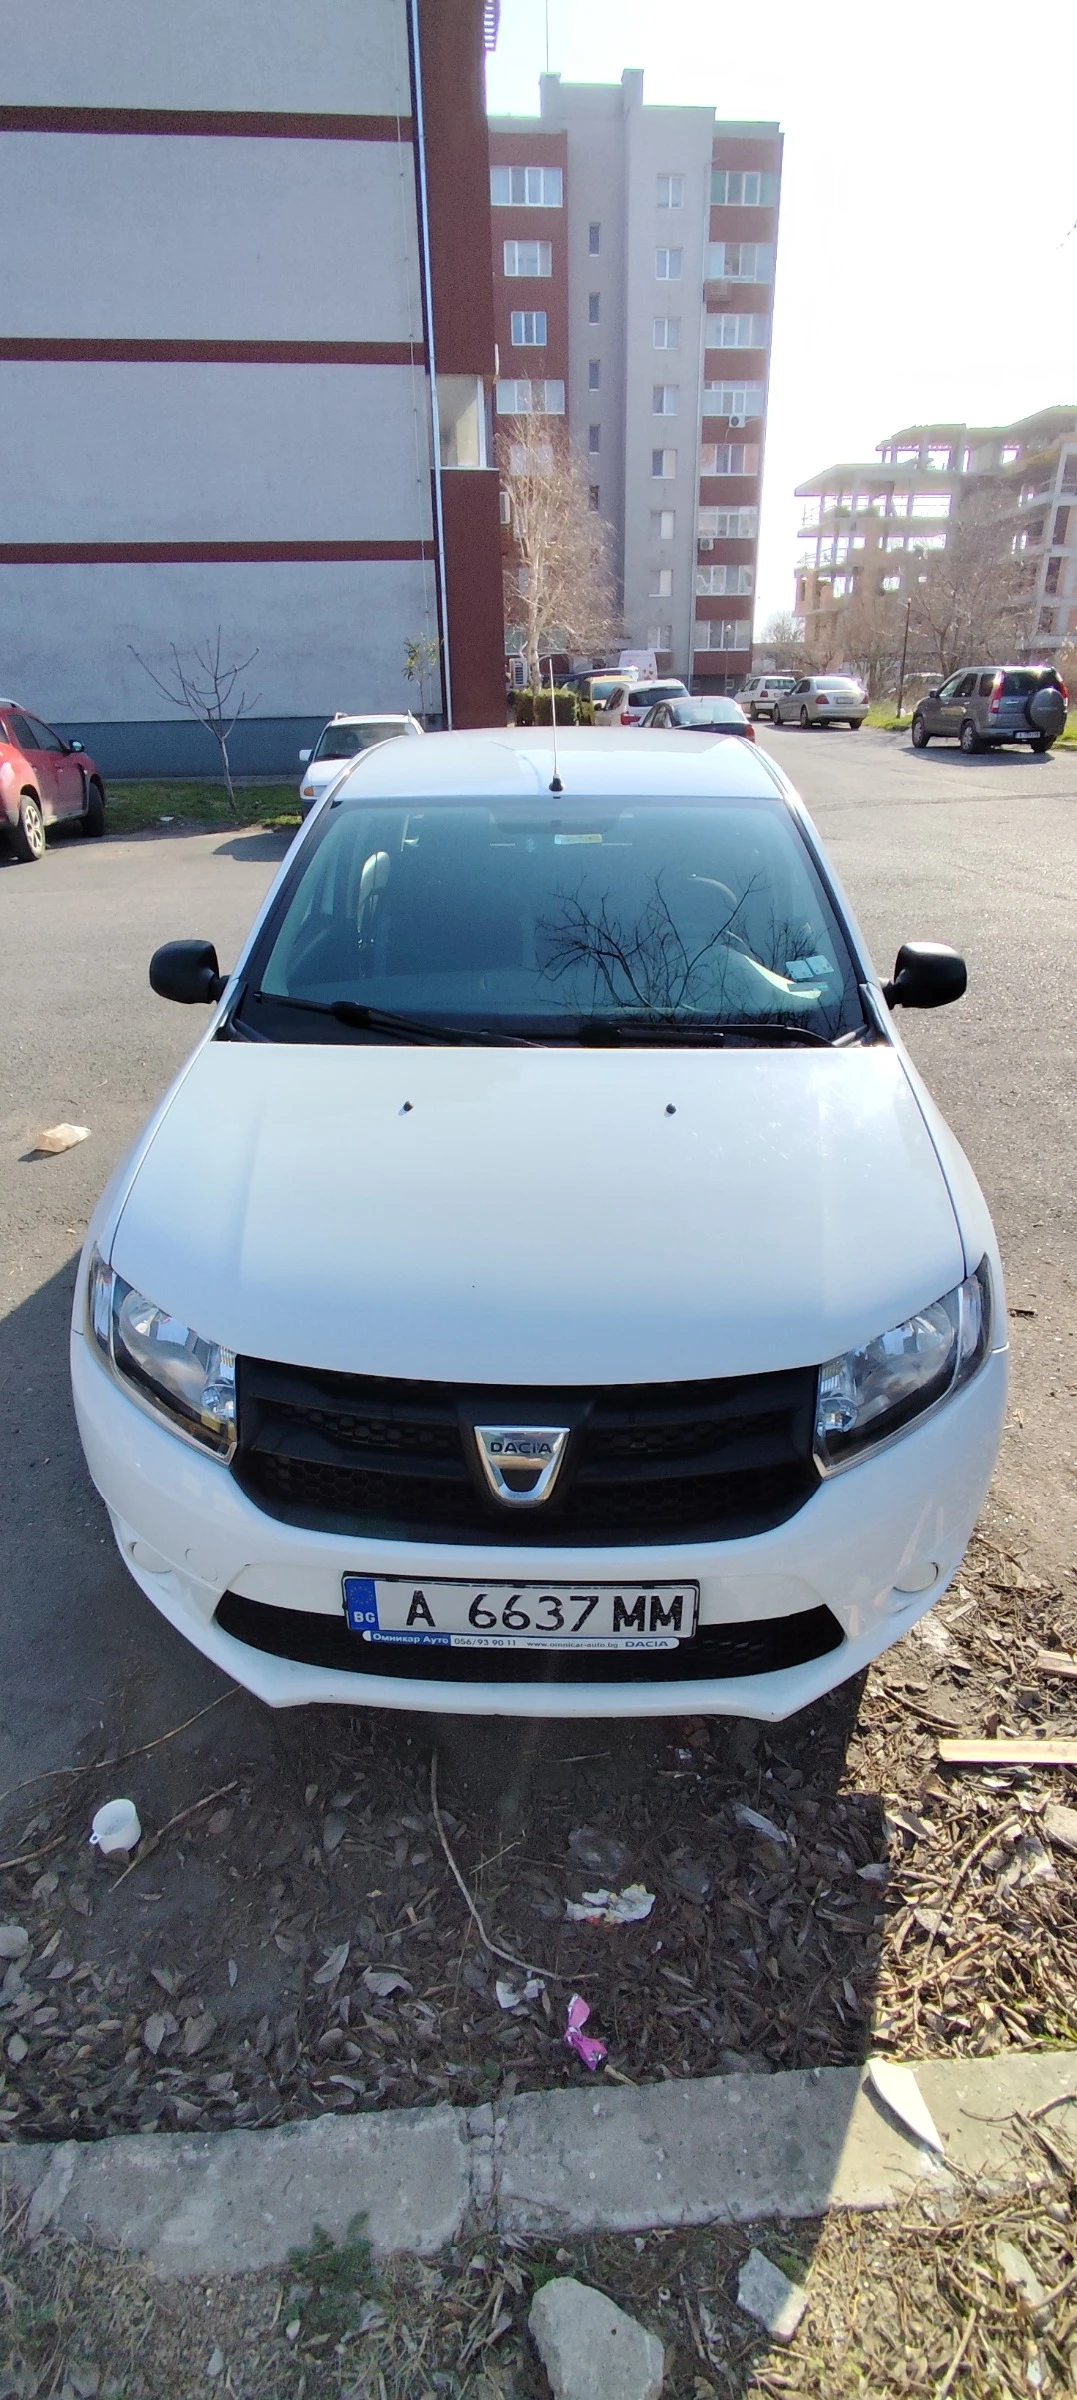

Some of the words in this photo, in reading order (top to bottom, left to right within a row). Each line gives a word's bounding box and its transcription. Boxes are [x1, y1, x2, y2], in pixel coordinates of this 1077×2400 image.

[490, 1442, 552, 1454] DACIA
[353, 1611, 376, 1623] BG
[406, 1590, 436, 1627] A
[468, 1593, 599, 1632] 6637
[612, 1595, 684, 1632] MM
[372, 1633, 420, 1643] Омникар
[422, 1636, 449, 1645] Ауто
[454, 1638, 490, 1647] 056/93
[492, 1639, 504, 1647] 90
[625, 1640, 669, 1648] DACIA
